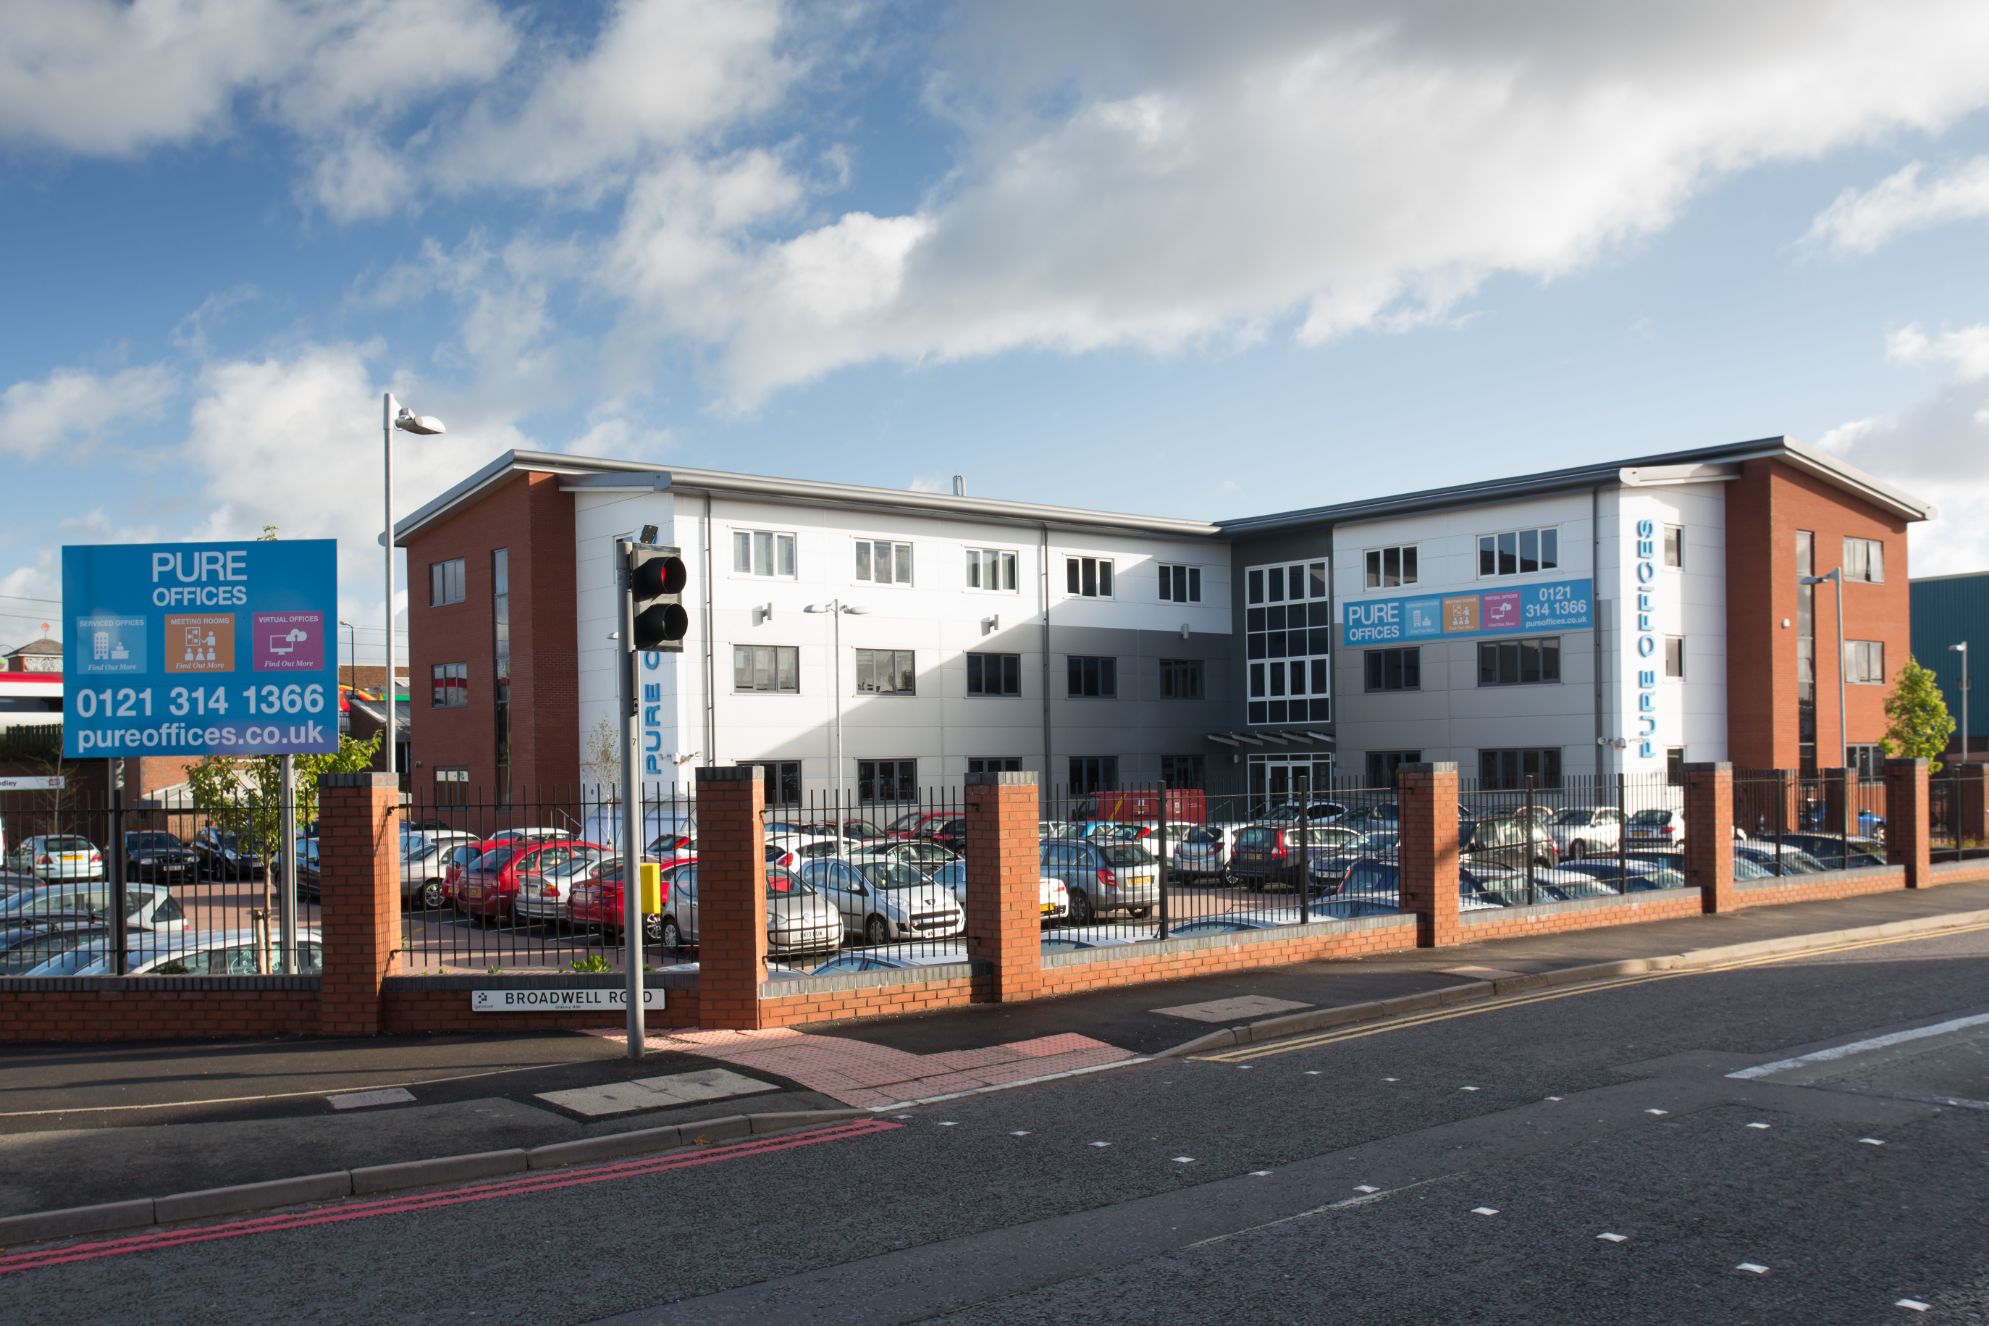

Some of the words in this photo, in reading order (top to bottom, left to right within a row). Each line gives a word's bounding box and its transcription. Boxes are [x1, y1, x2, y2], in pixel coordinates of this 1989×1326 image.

[152, 550, 247, 582] PURE
[153, 586, 247, 607] OFFICES
[1539, 586, 1571, 601] 0121
[1637, 519, 1655, 658] OFFICES
[1349, 602, 1400, 625] PURE
[1526, 603, 1549, 618] 314
[1554, 600, 1587, 615] 1366
[80, 619, 114, 627] SERVICED
[115, 619, 144, 627] OFFICES
[289, 615, 319, 623] OFFICES
[1526, 616, 1587, 629] pureoffices.co.uk
[1349, 625, 1399, 641] OFFICES
[88, 663, 104, 671] Find
[264, 660, 280, 668] Find
[77, 687, 152, 718] 0121
[169, 686, 228, 716] 314
[242, 683, 325, 715] 1366
[1639, 670, 1656, 758] PURE
[78, 719, 324, 753] pureoffices.co.uk
[644, 683, 662, 775] PURE
[505, 991, 602, 1004] BROADWELL
[609, 991, 652, 1003] ROD
